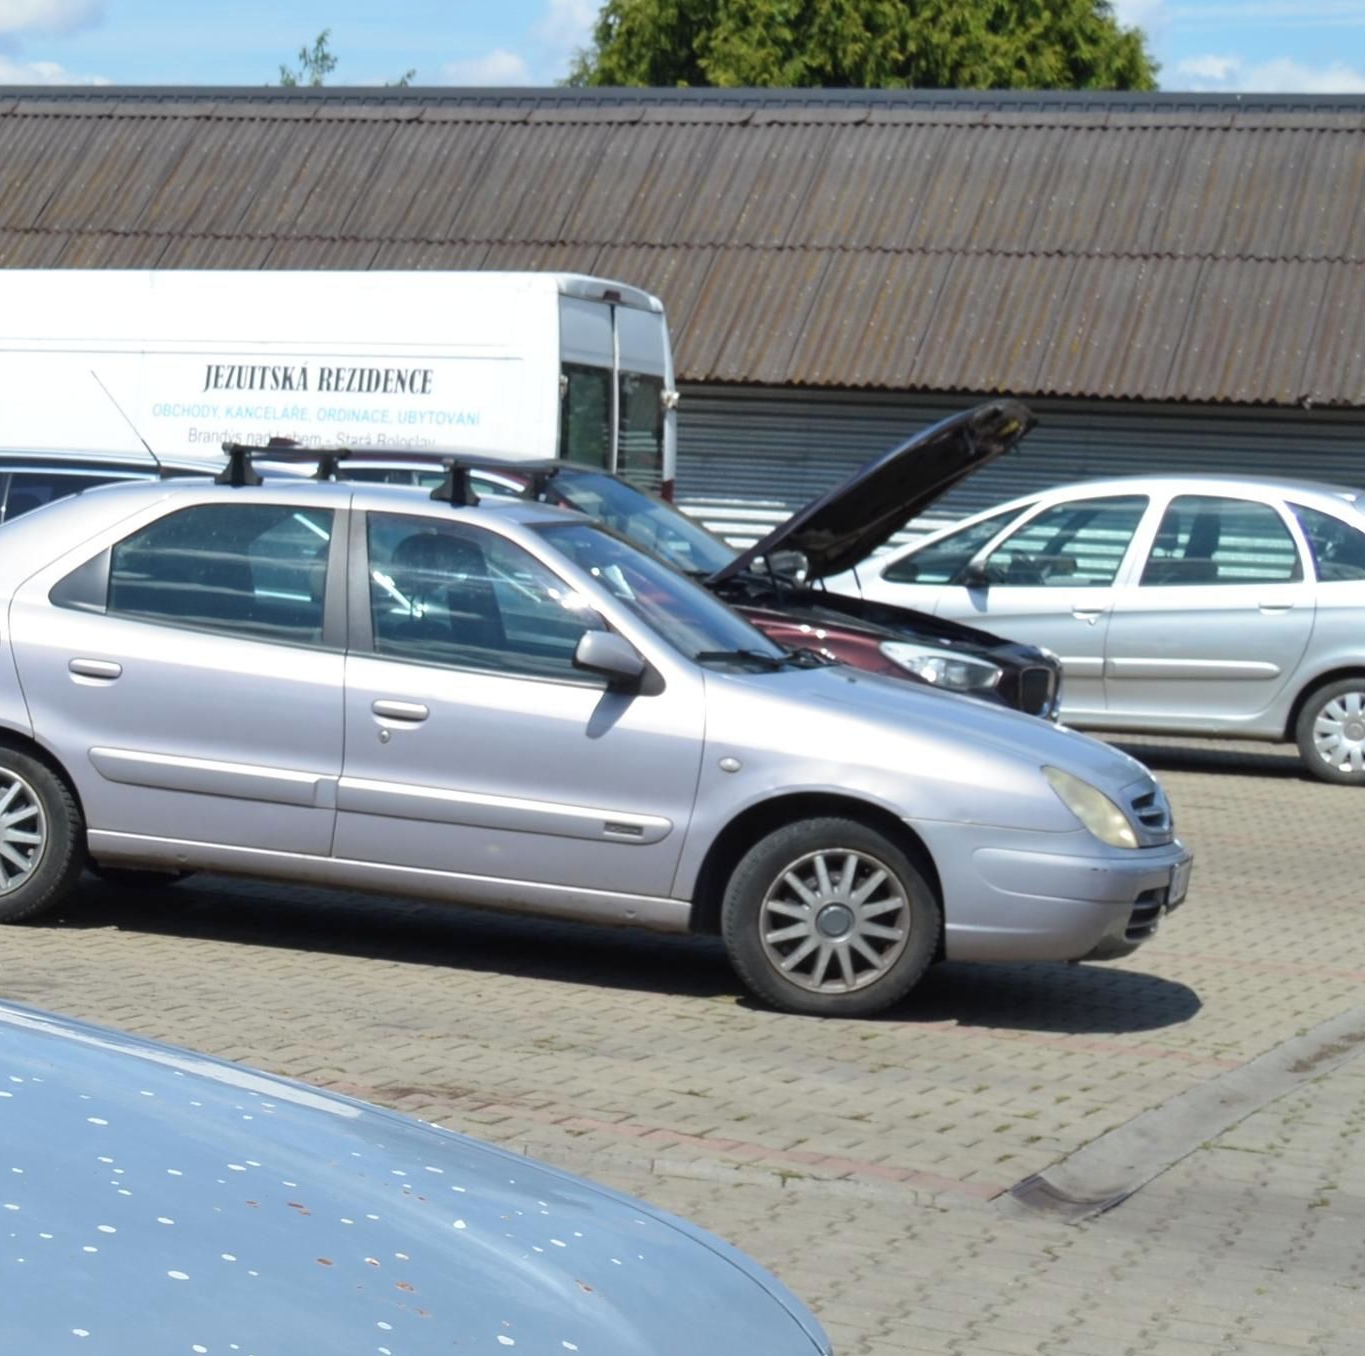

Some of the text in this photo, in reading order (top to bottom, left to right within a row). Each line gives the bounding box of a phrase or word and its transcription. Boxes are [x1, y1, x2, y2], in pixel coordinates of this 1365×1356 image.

[202, 361, 433, 395] JEZUITSKÁ REZIDENCE
[152, 402, 220, 420] OBCHODY,
